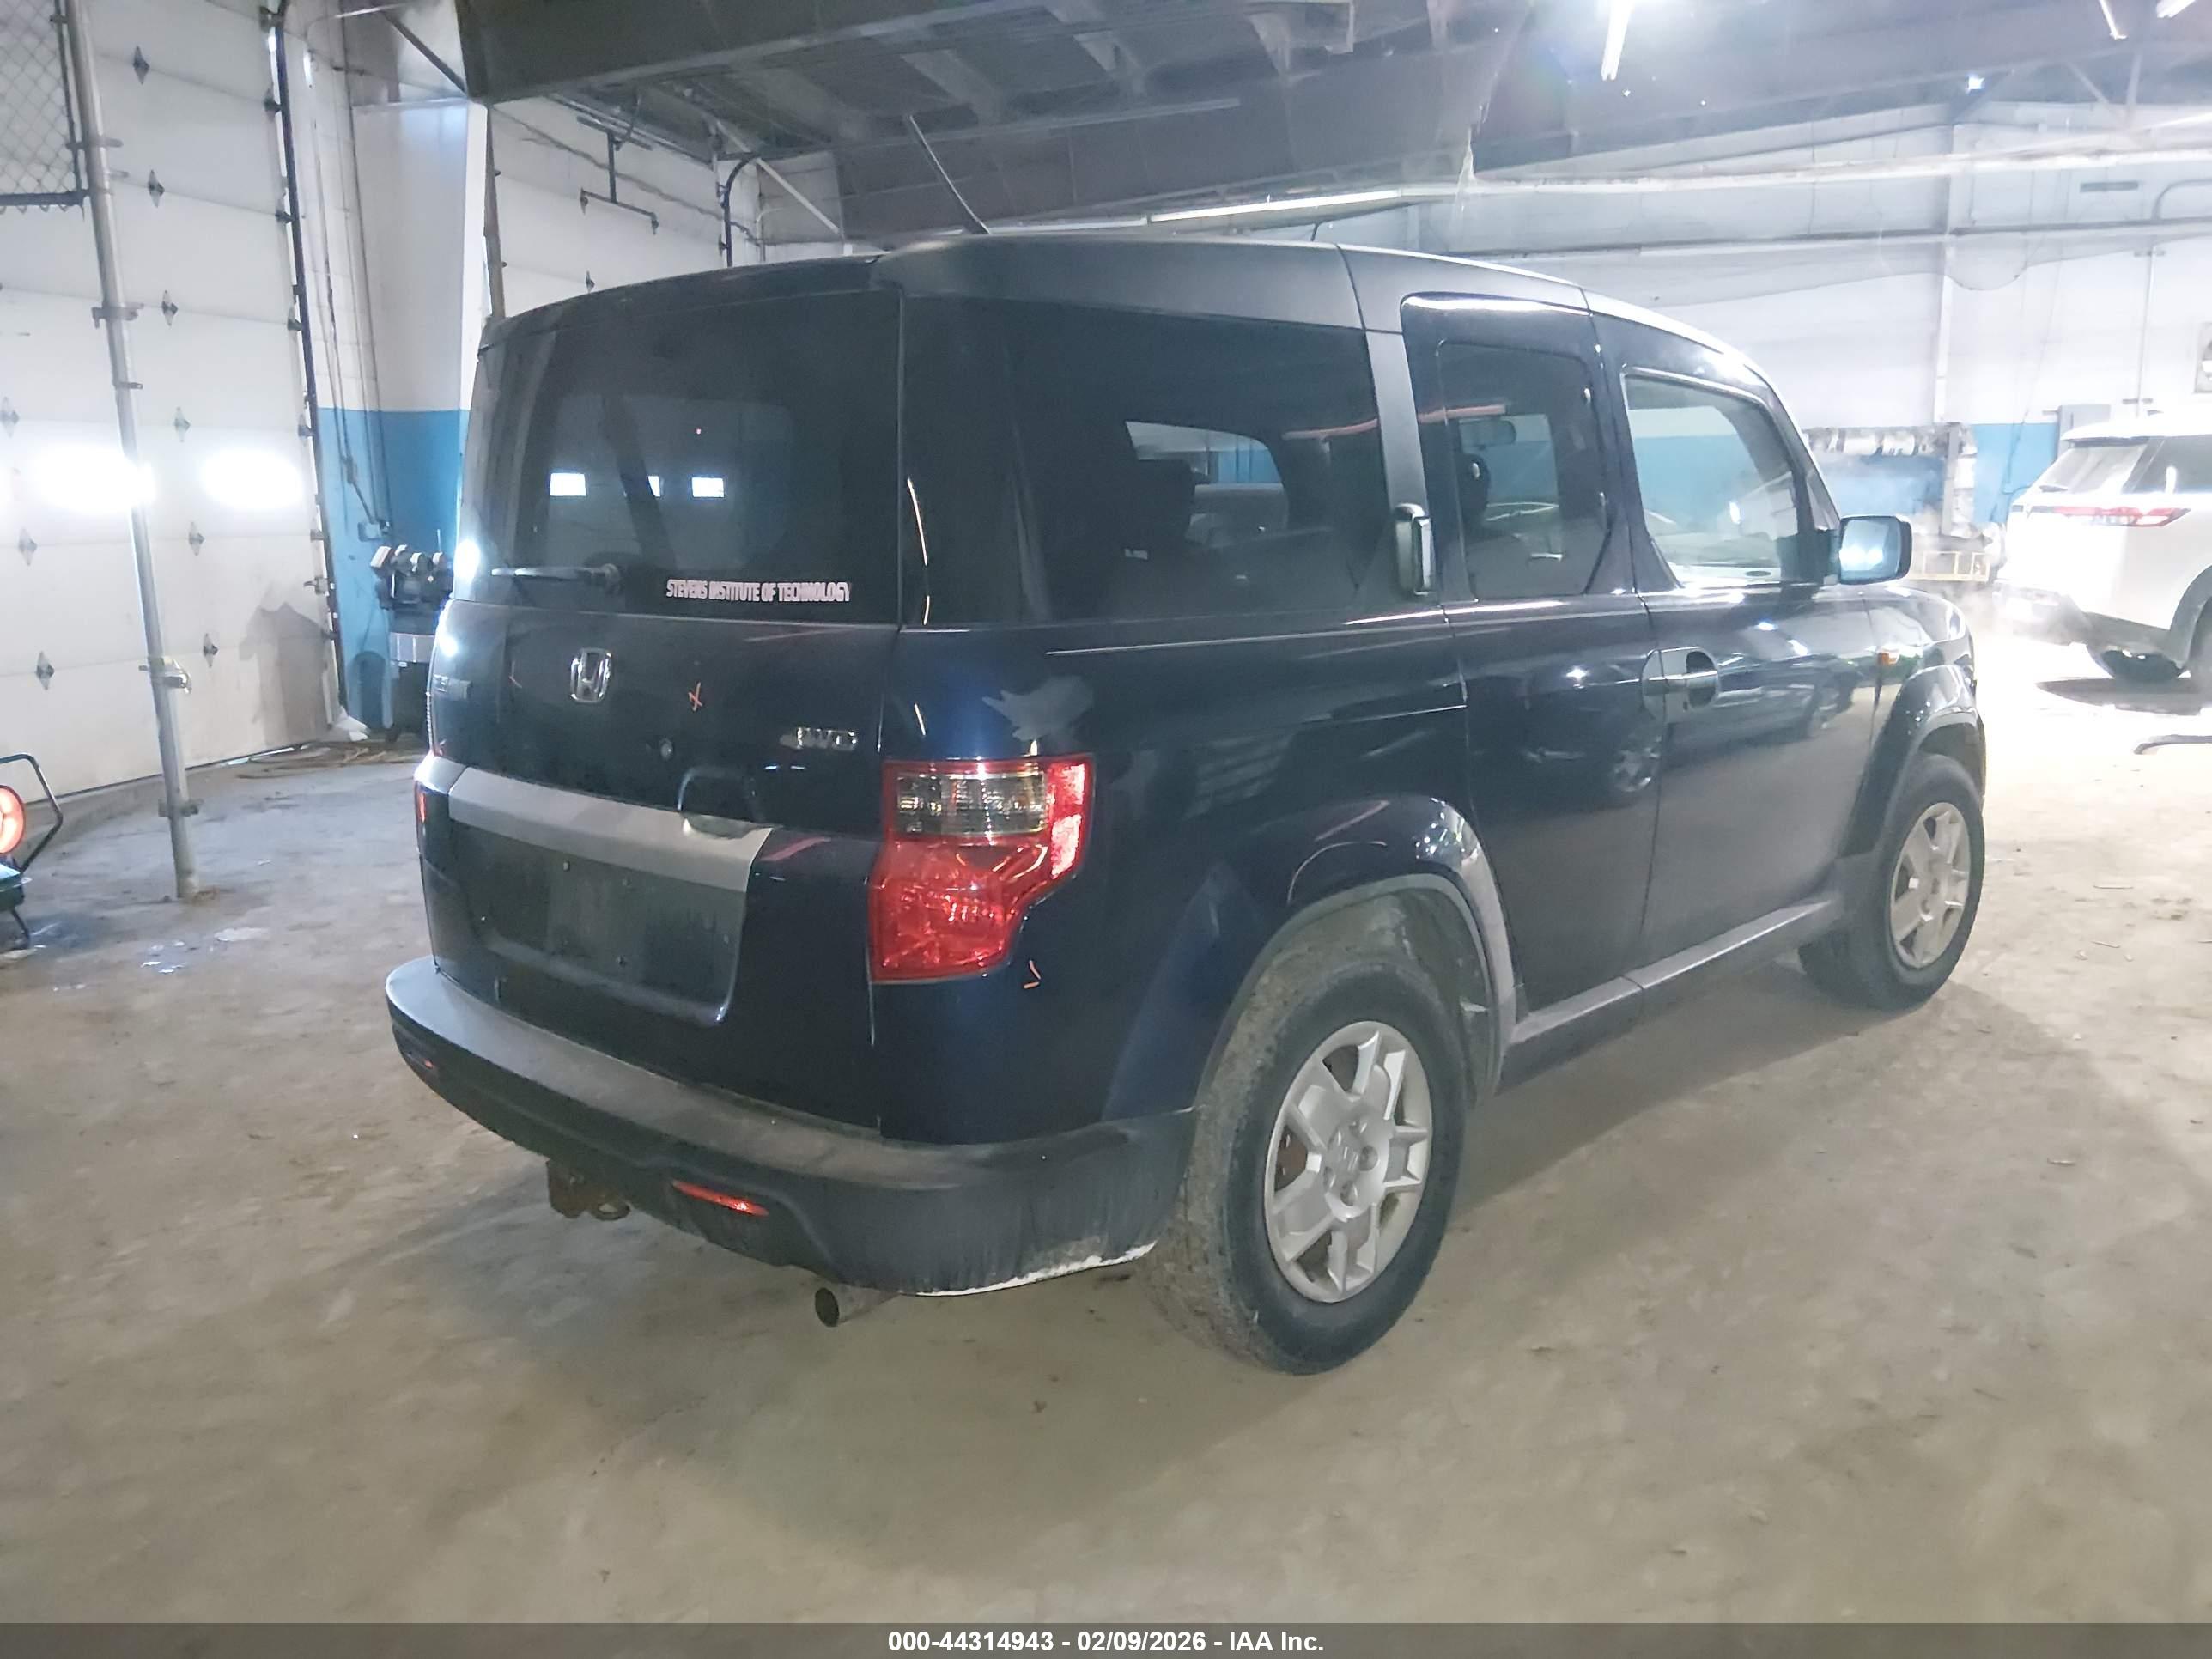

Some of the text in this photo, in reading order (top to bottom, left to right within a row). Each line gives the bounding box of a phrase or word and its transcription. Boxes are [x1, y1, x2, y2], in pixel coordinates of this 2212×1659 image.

[666, 580, 851, 602] STEVENS INSTITUTE OF TECHNOLOGY
